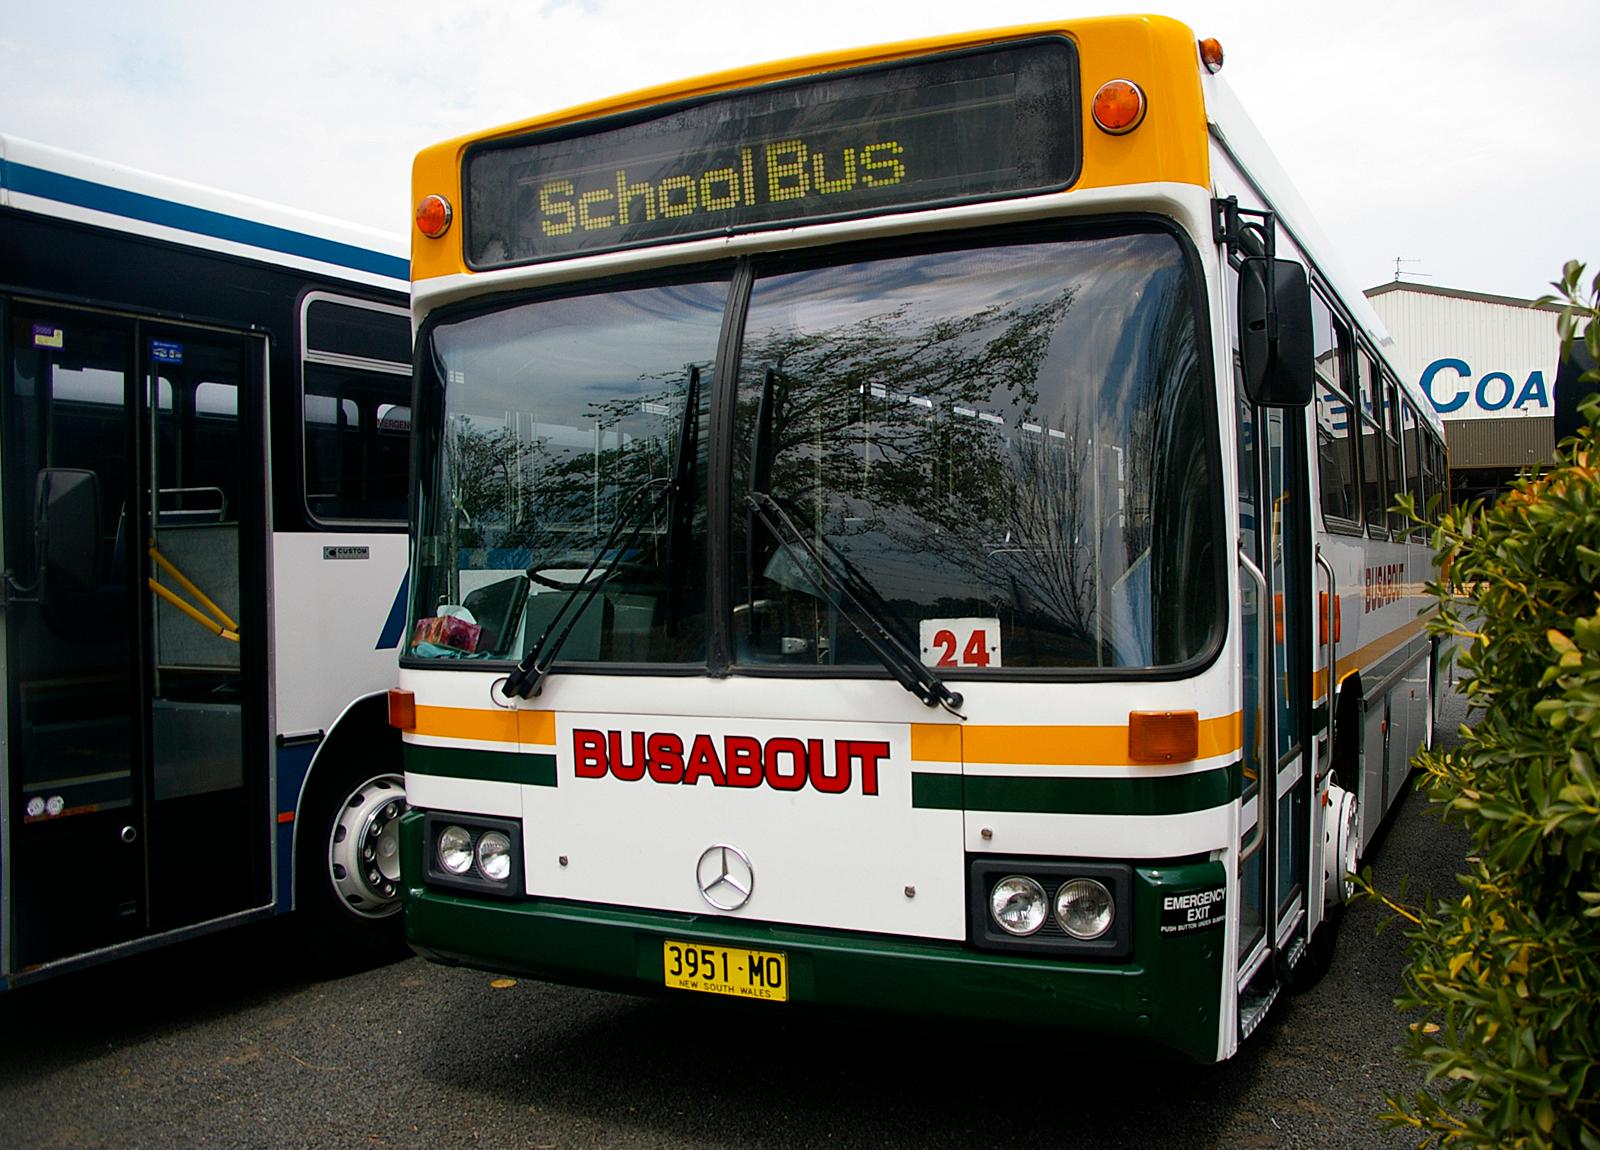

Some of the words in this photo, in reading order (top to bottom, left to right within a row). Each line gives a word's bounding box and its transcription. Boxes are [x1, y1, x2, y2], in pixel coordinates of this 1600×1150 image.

[542, 148, 755, 237] School
[766, 140, 905, 201] Bus
[1419, 359, 1556, 413] COA
[1365, 563, 1405, 613] BUSABOUT
[933, 630, 990, 667] 24
[572, 728, 891, 797] BUSABOUT
[1163, 888, 1226, 910] EMERGENCY
[1187, 906, 1210, 922] EXIT
[1178, 922, 1197, 931] BUTTON
[679, 980, 699, 988] NEW
[703, 983, 735, 993] SOUTH
[739, 987, 771, 998] WALES
